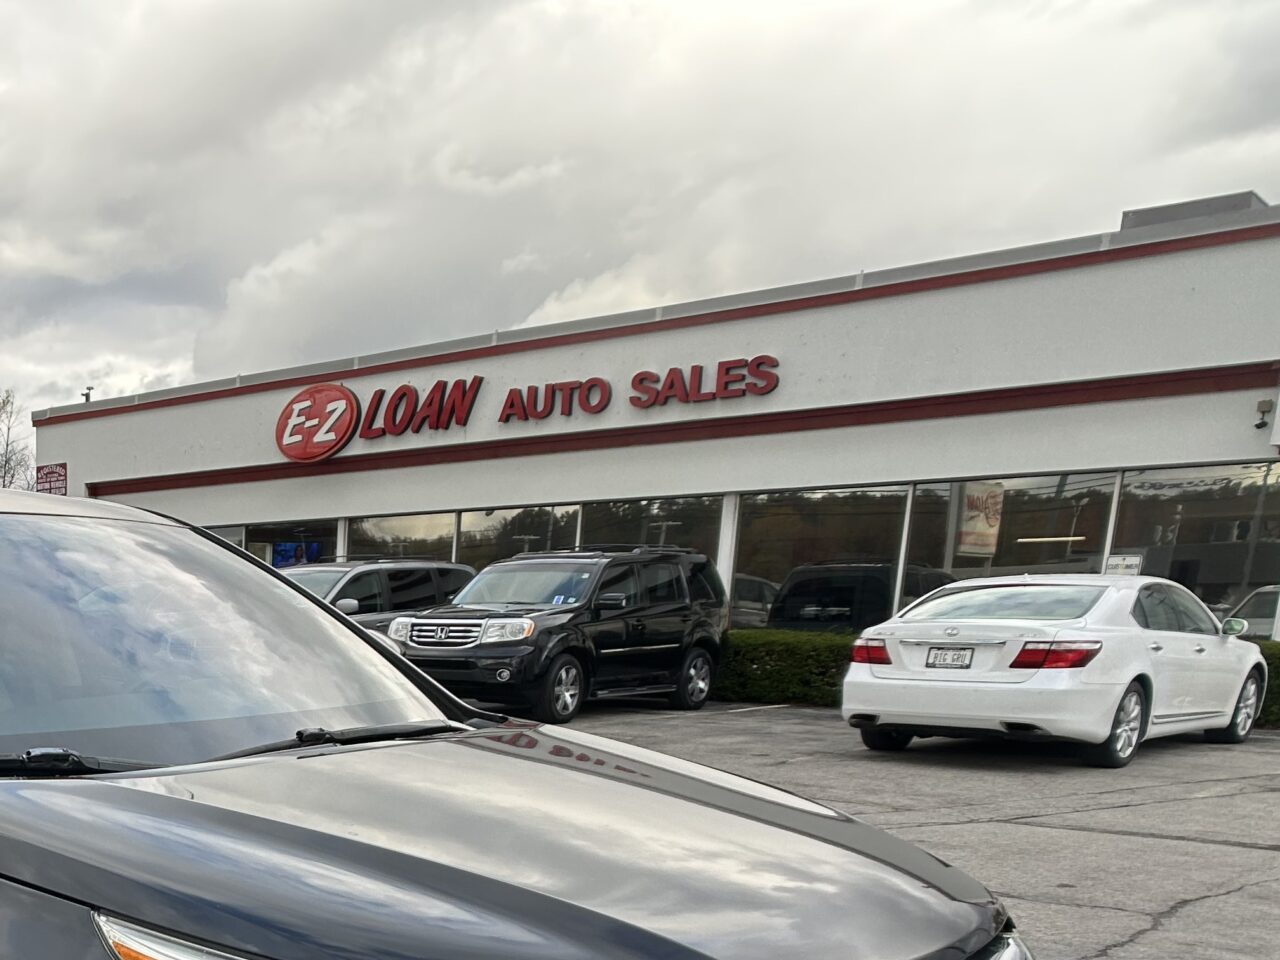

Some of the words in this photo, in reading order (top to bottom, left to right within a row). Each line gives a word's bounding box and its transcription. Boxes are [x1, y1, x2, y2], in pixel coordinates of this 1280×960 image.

[282, 399, 347, 446] E-Z
[359, 375, 484, 440] LOAN
[498, 377, 612, 423] AUTO
[629, 355, 779, 409] SALES
